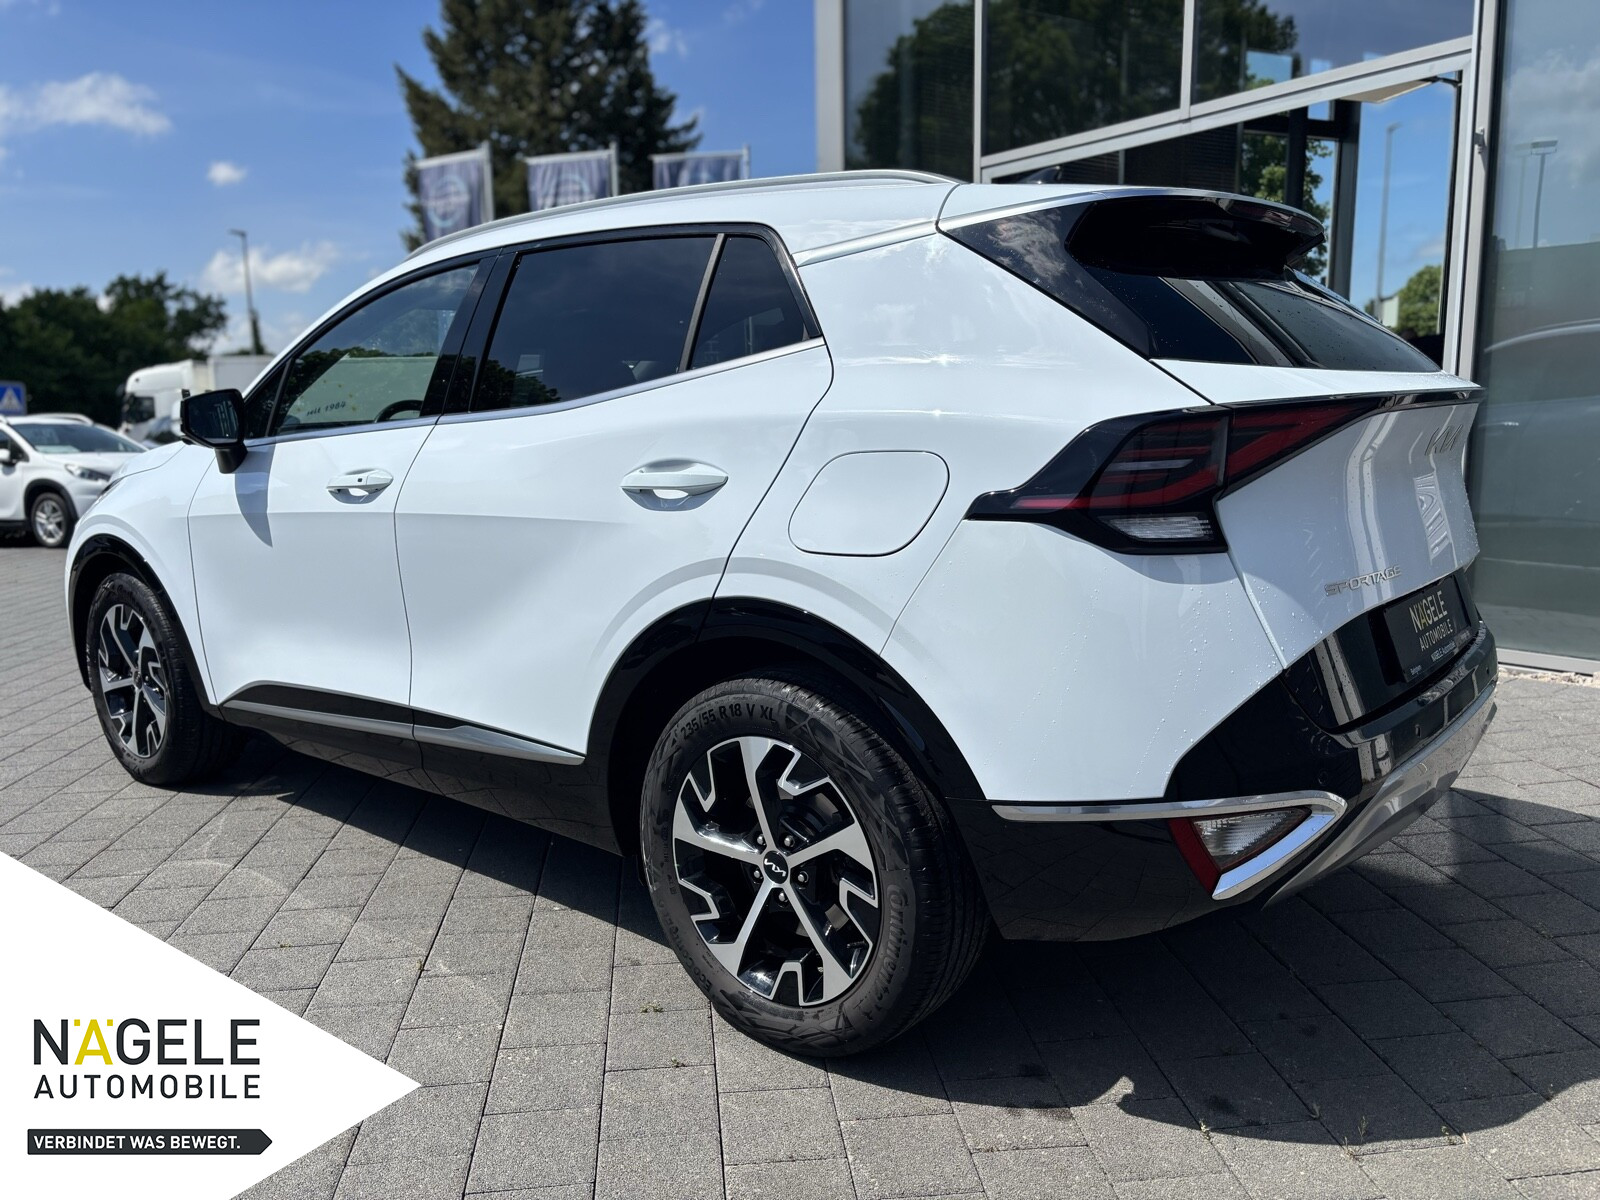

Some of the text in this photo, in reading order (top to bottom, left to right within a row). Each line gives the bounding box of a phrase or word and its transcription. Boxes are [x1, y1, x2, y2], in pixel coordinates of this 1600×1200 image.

[1324, 564, 1402, 597] SPORTAGE
[1420, 618, 1454, 652] AUTOMOBILE
[681, 707, 717, 740] 235/55
[746, 703, 756, 718] V
[760, 704, 775, 723] XL
